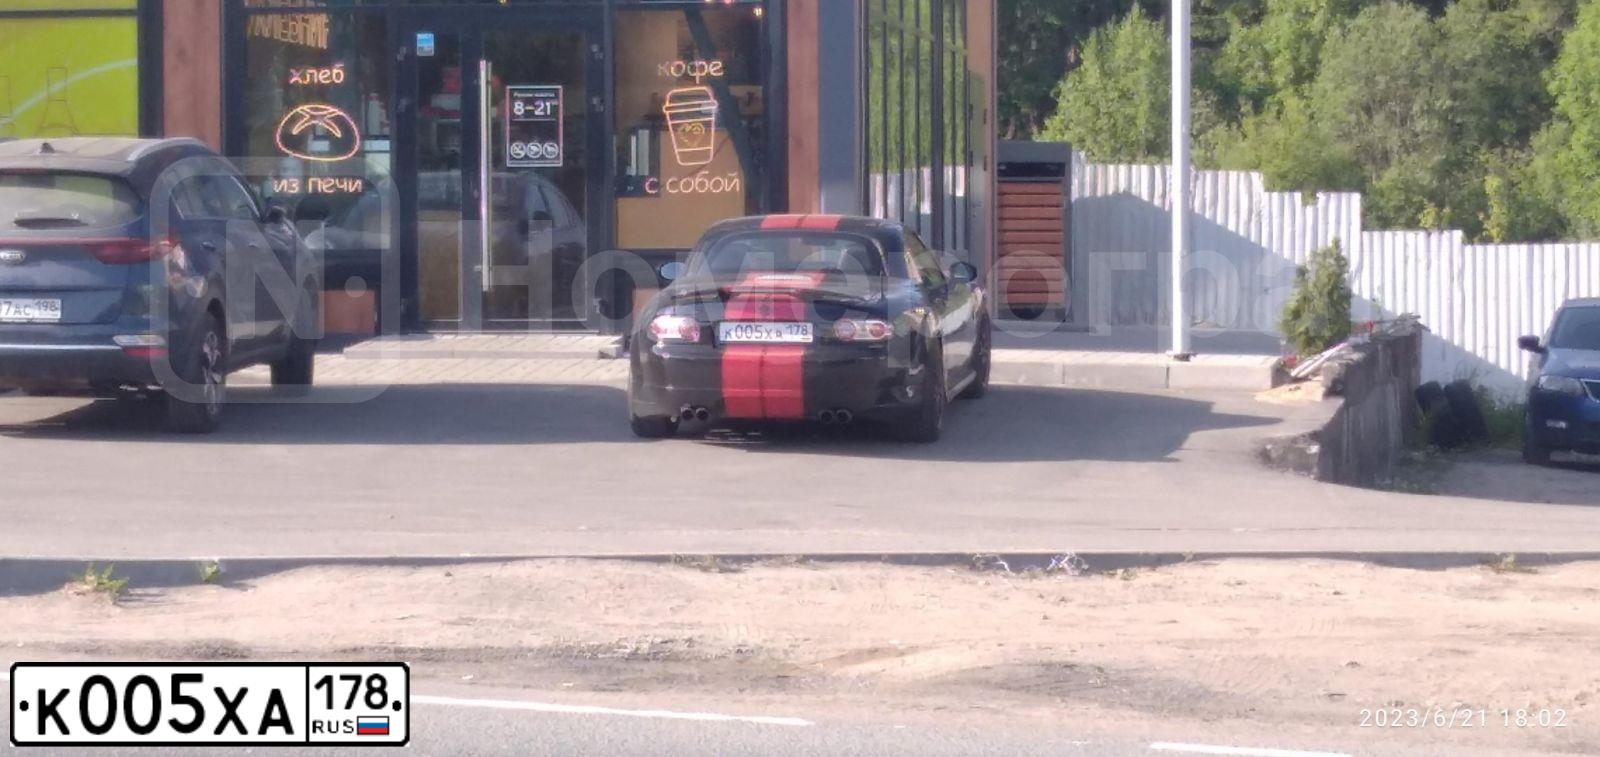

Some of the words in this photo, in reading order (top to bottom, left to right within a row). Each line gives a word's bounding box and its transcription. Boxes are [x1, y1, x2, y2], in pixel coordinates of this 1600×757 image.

[289, 62, 345, 84] хлеб
[658, 60, 724, 84] кофе
[273, 179, 299, 193] из
[308, 178, 363, 194] печи
[645, 178, 660, 193] с
[666, 171, 740, 193] собой
[0, 301, 31, 315] 7АС
[785, 325, 808, 335] 178
